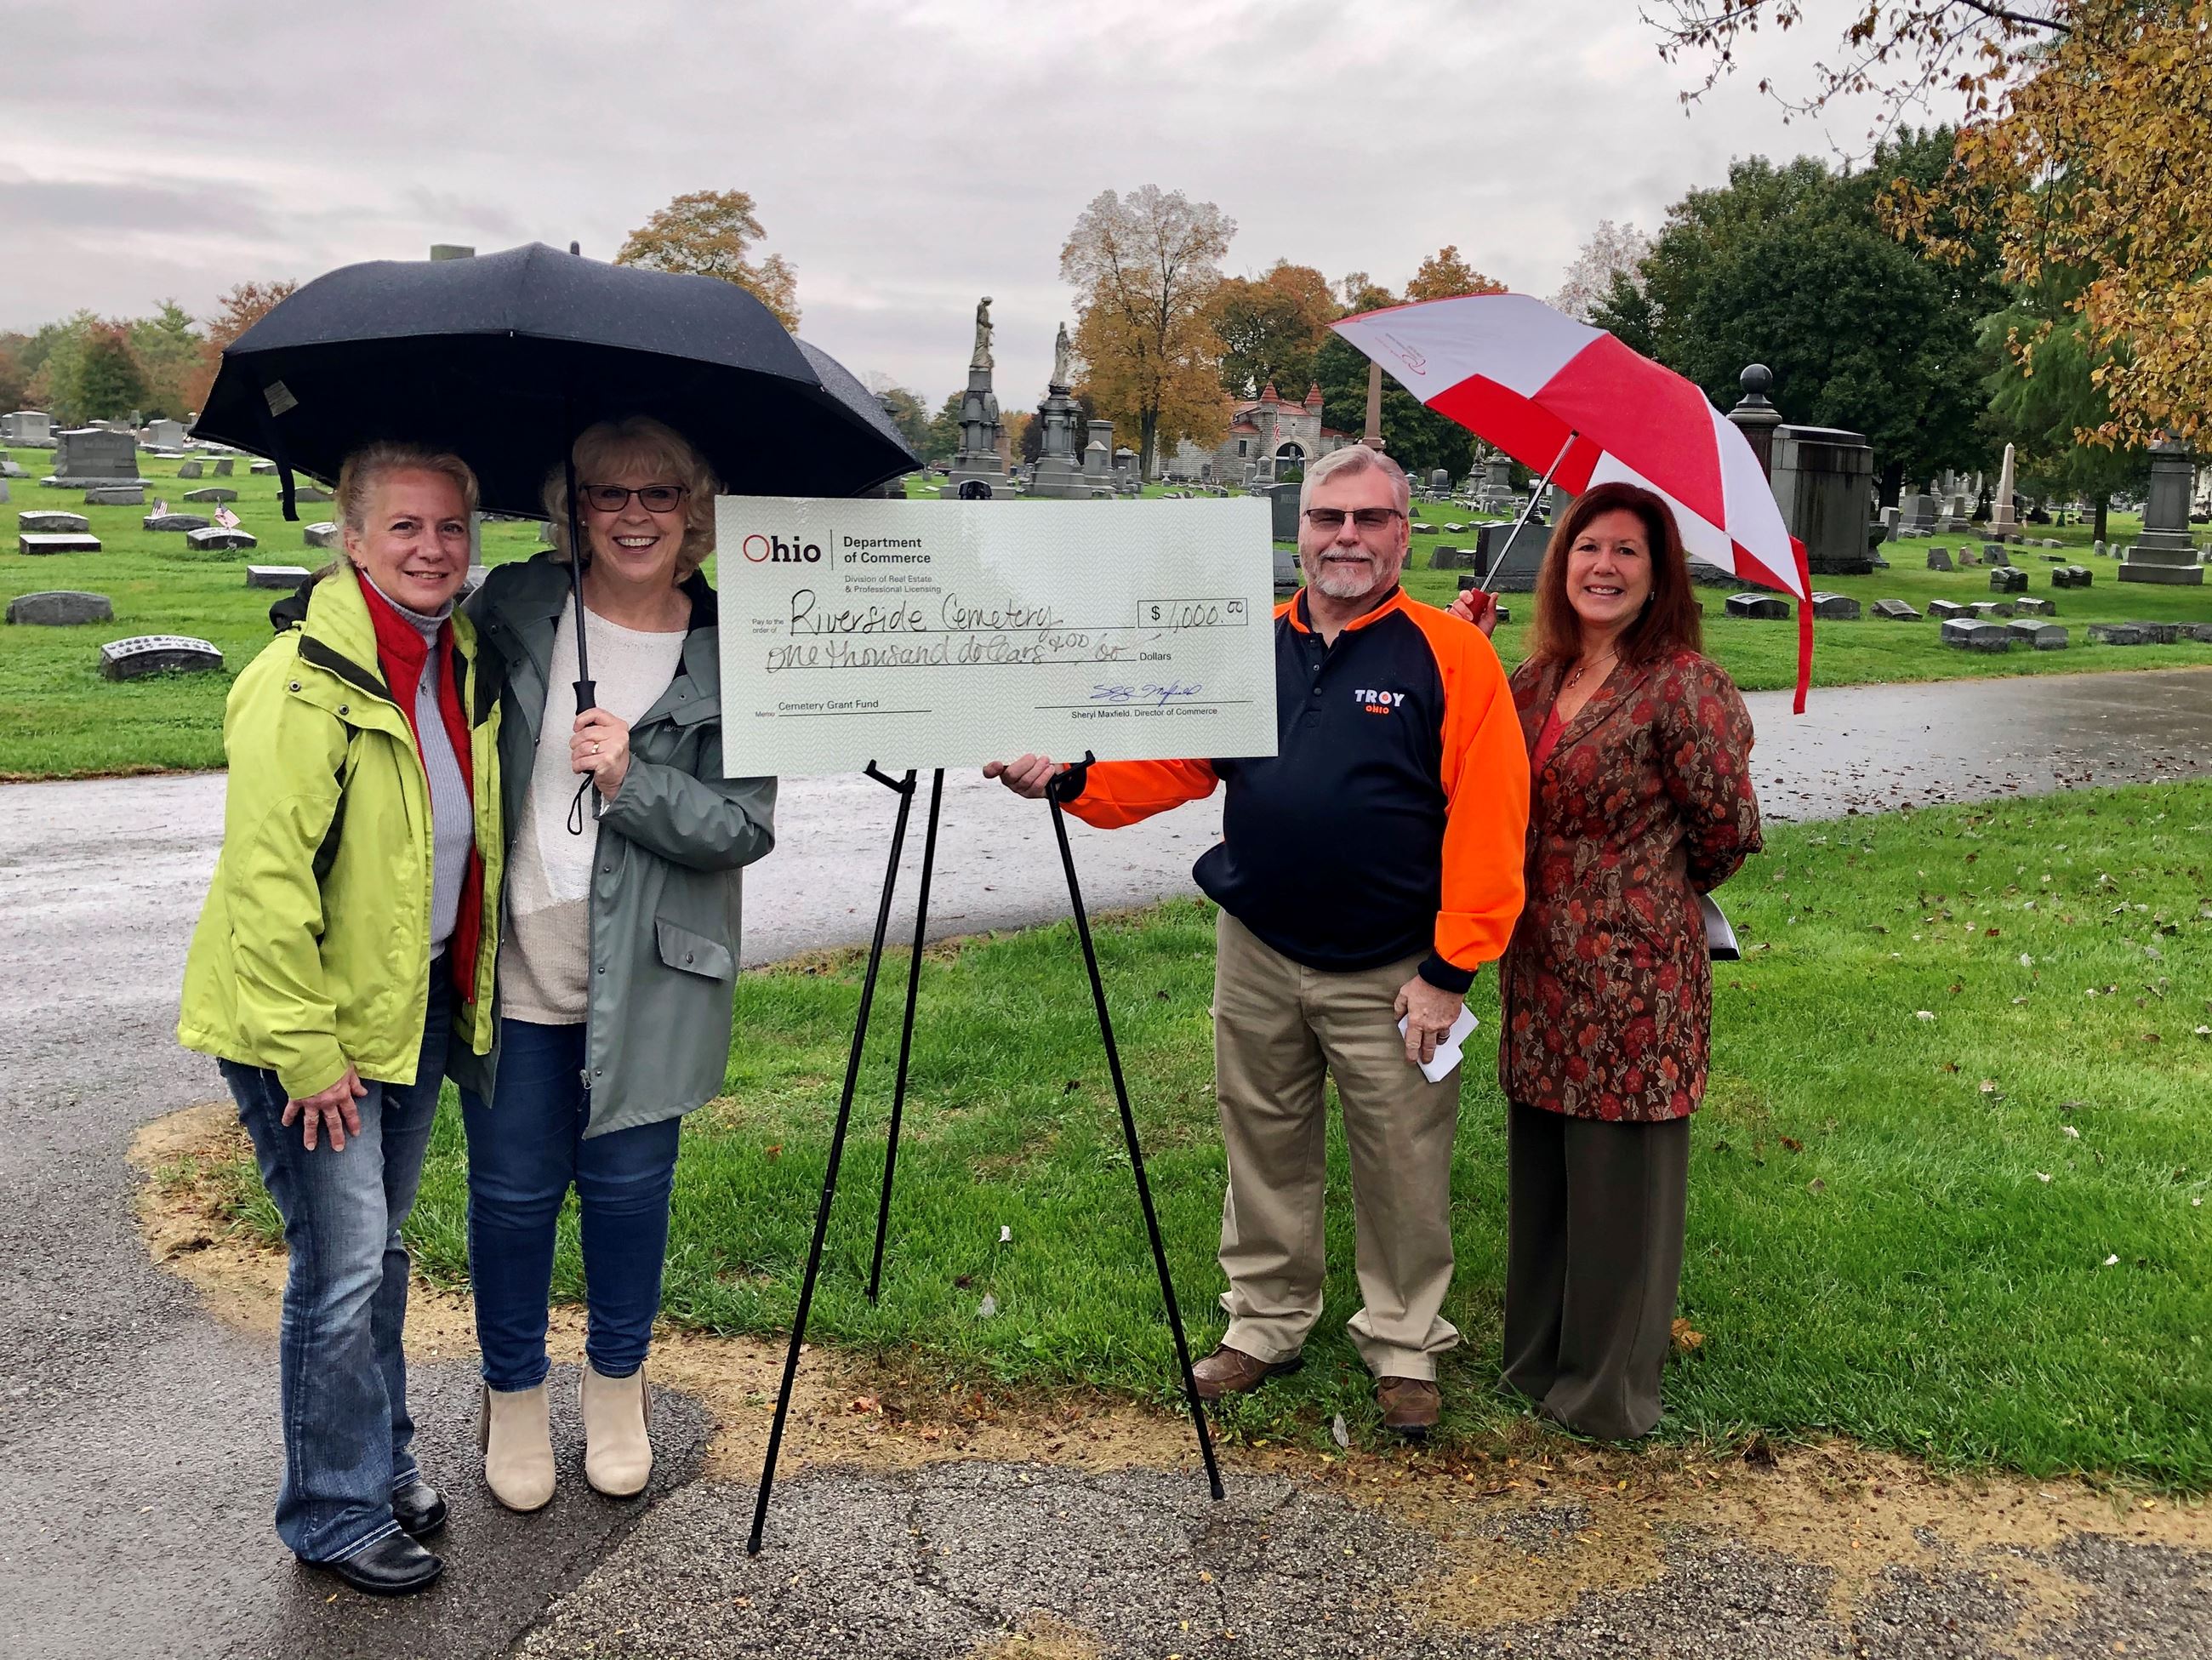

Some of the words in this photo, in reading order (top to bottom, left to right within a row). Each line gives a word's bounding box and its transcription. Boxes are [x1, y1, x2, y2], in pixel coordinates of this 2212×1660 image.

[744, 534, 821, 562] Ohio
[844, 536, 921, 550] Department
[844, 552, 857, 562] of
[861, 552, 931, 563] Commerce
[904, 585, 942, 595] Licensing
[790, 589, 926, 636] Riverside
[942, 593, 1063, 642] Cemetery
[767, 644, 818, 673] one
[825, 635, 950, 669] thousand
[958, 634, 1046, 665] dollars
[1139, 652, 1172, 661] Dollars
[1354, 689, 1405, 707] TROY
[778, 701, 824, 711] Cemetery
[827, 700, 853, 710] Grant
[856, 699, 880, 709] Fund
[1365, 705, 1389, 715] OHIO
[1071, 710, 1096, 720] Sheryl
[1134, 708, 1165, 718] Director
[1166, 708, 1174, 716] of
[1176, 707, 1218, 716] Commerce
